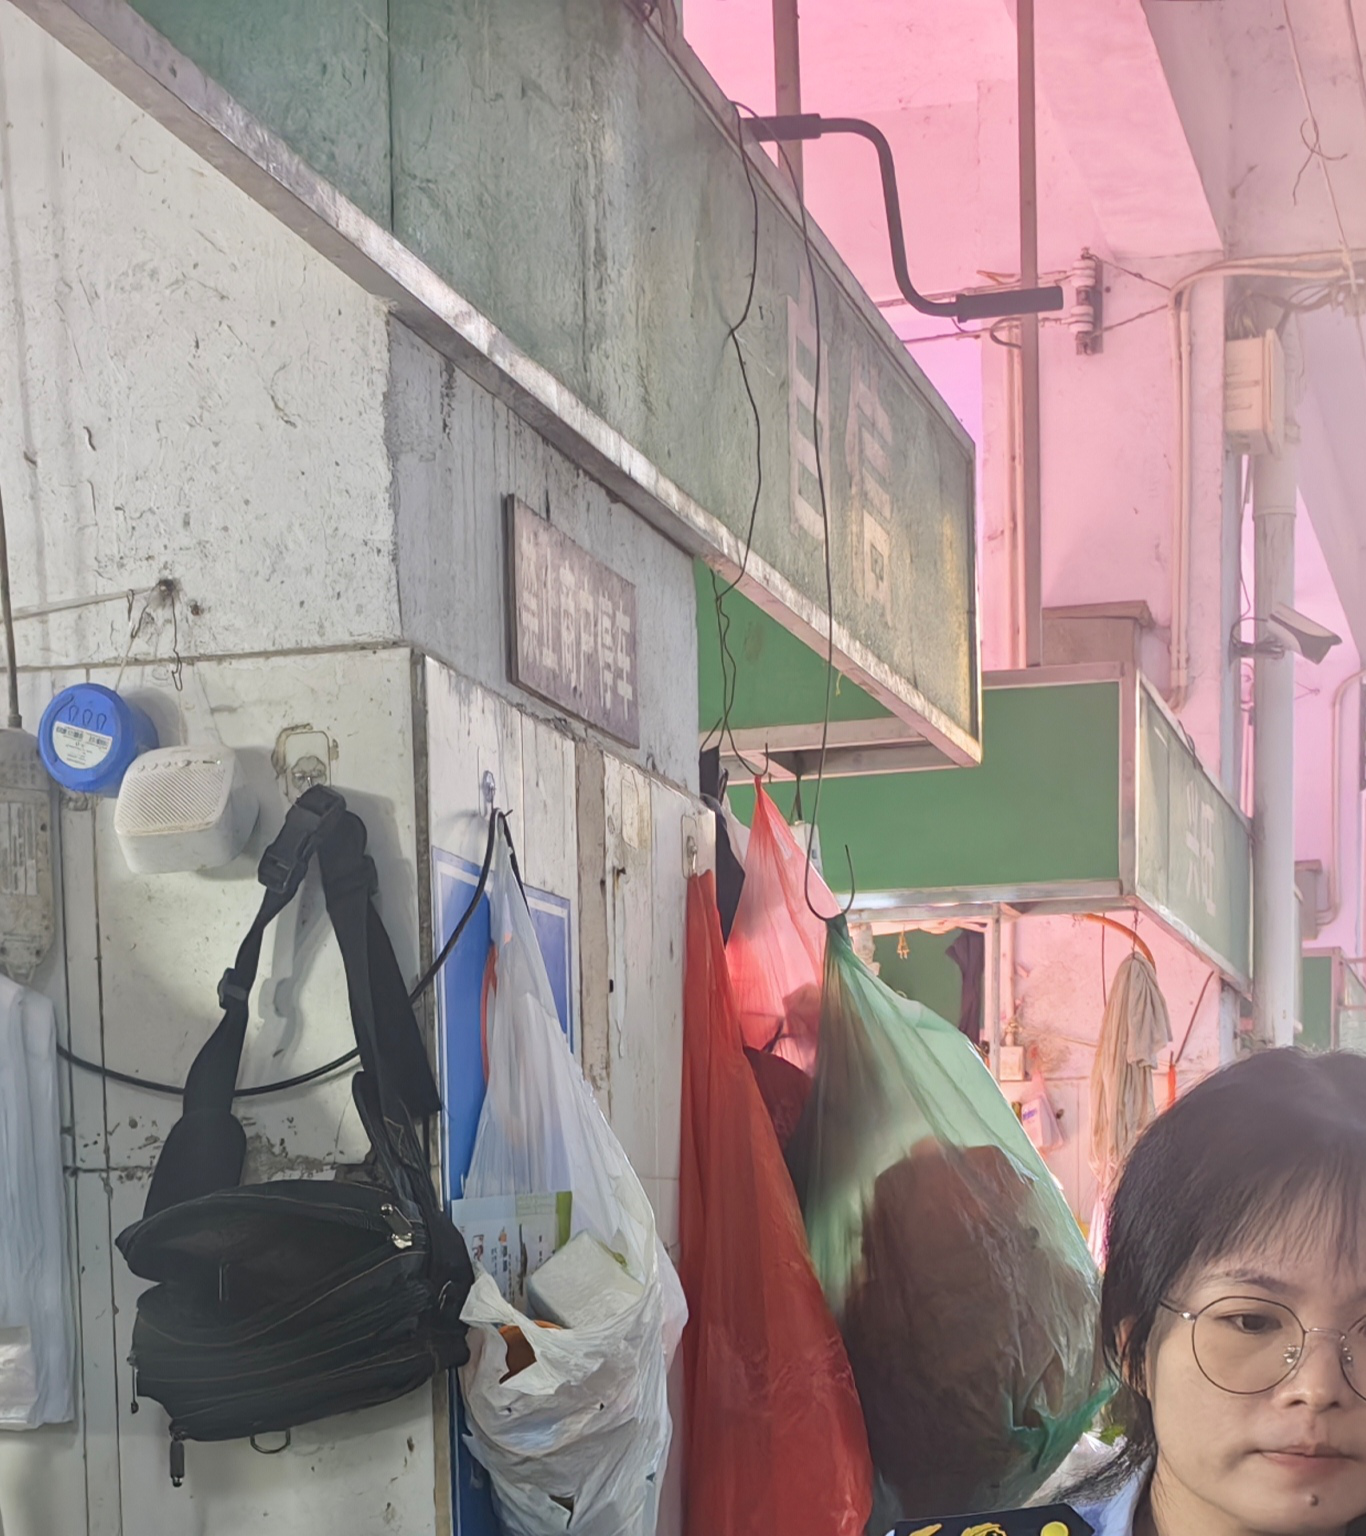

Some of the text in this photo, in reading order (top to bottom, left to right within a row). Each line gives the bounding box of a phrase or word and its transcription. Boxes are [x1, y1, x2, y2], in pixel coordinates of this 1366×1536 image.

[521, 531, 633, 721] 禁止商户停车
